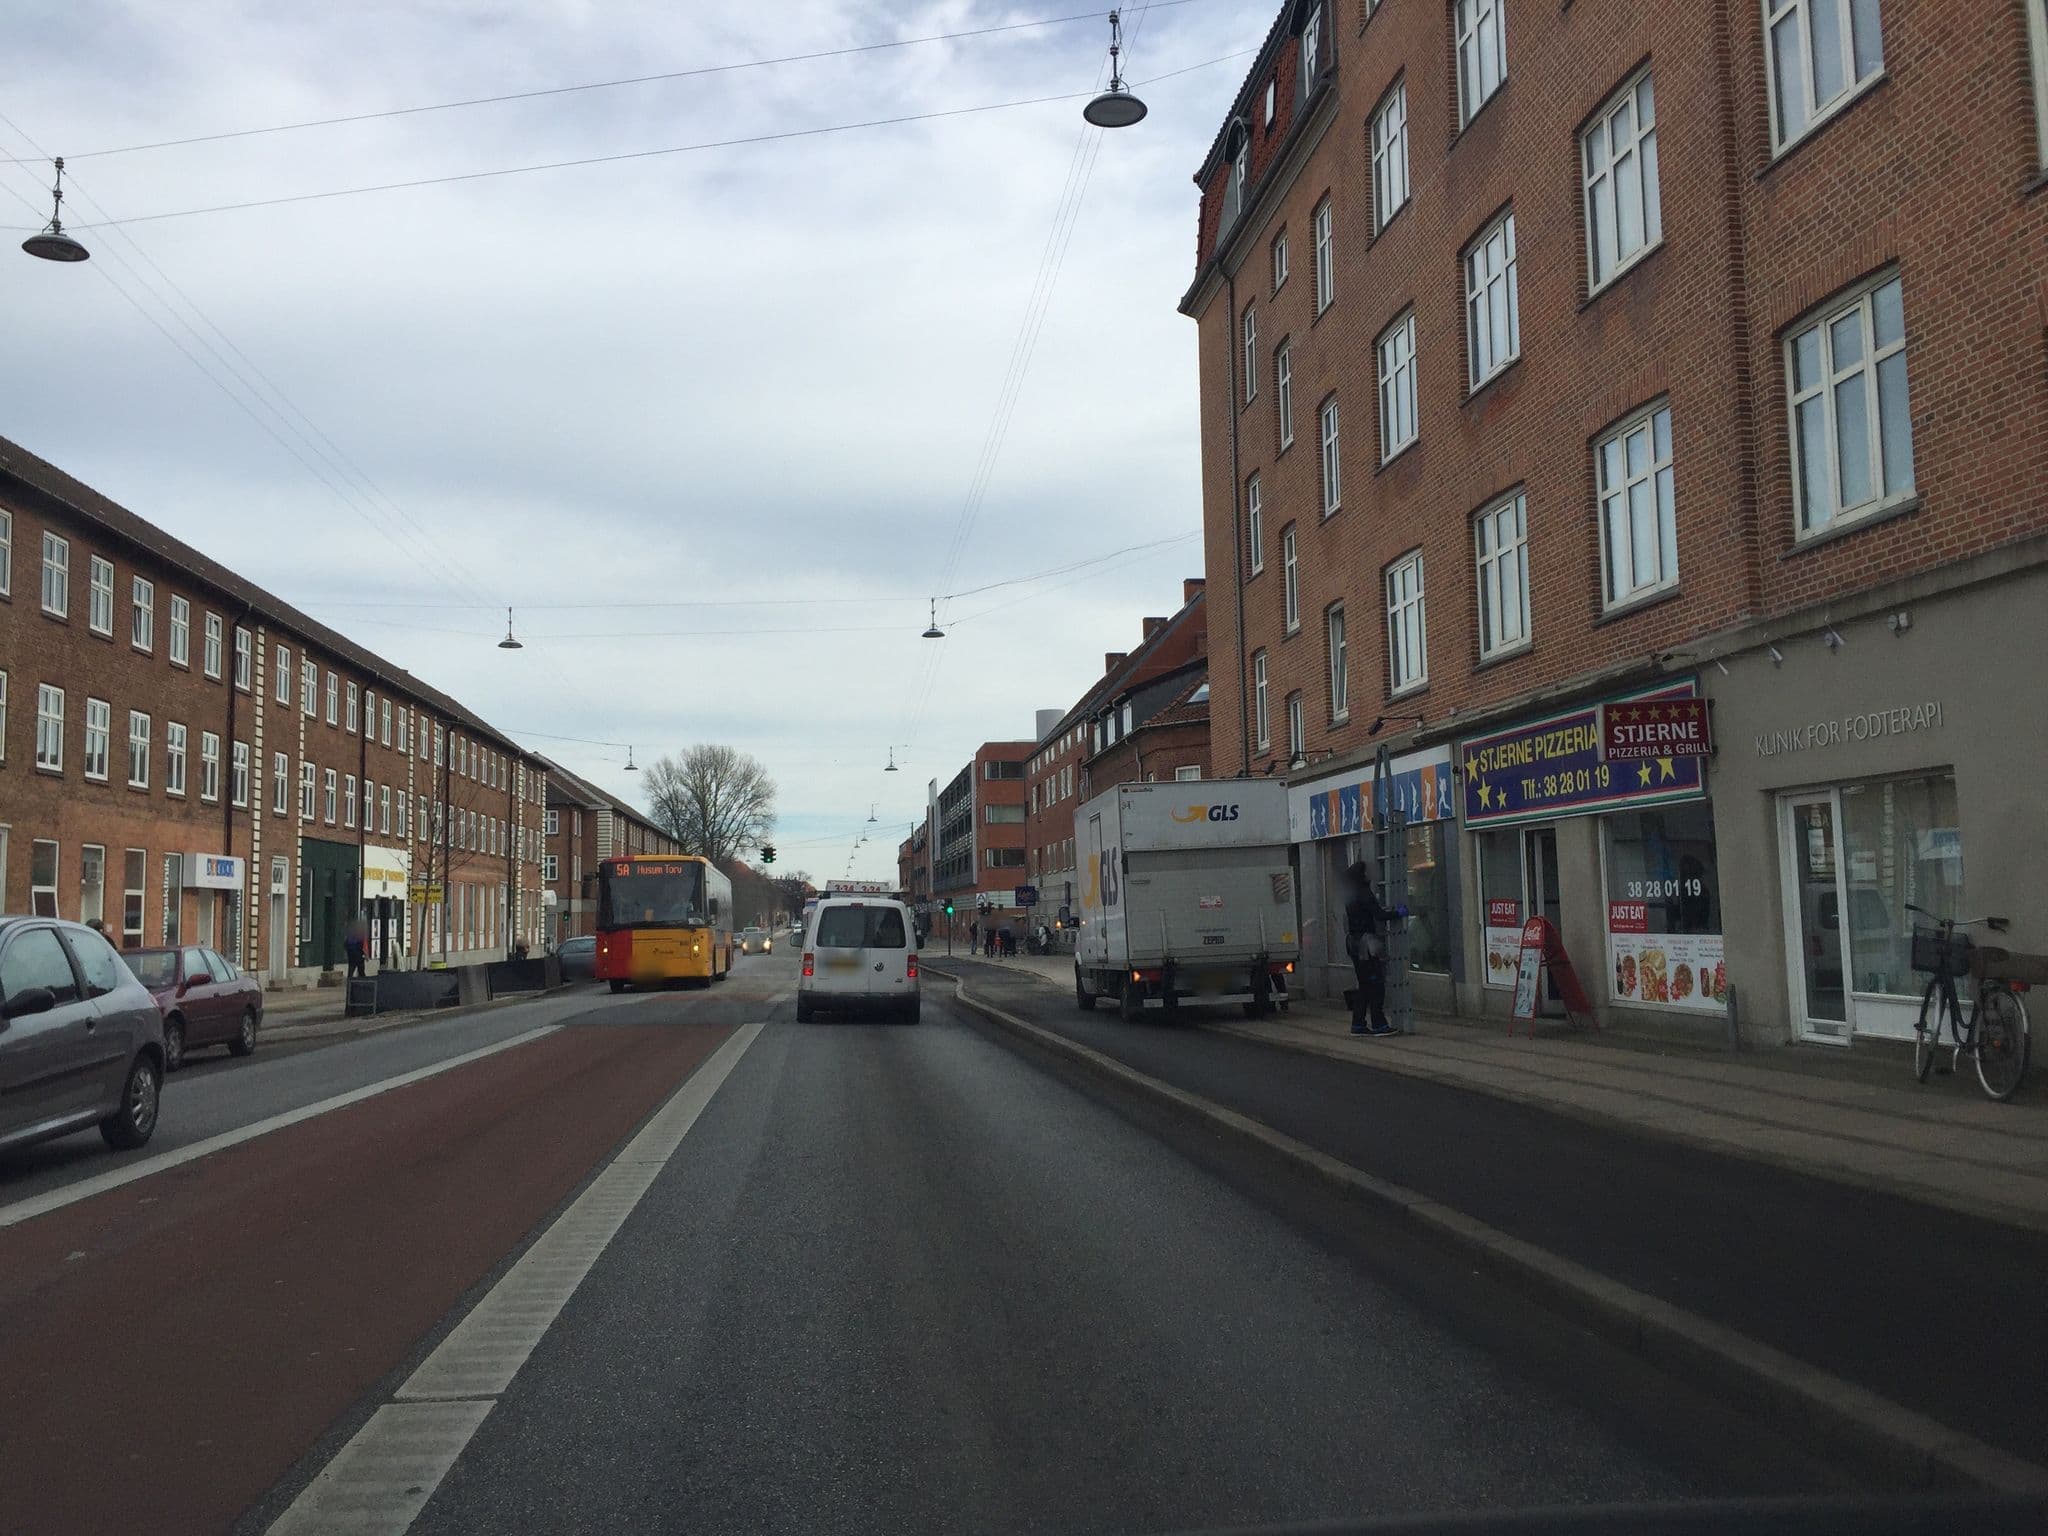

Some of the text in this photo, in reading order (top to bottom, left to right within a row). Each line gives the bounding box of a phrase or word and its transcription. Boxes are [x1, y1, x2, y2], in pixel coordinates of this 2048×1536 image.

[1613, 721, 1700, 744] STJERNE
[1756, 702, 1944, 757] KLINIK FOR FODTERAPI
[1479, 723, 1598, 773] STJERNE PIZZERIA
[1608, 742, 1710, 759] PIZZERIA & GRILL
[1521, 766, 1610, 800] Tlf.: 38 28 01 19
[1208, 804, 1239, 821] GLS
[616, 864, 630, 876] 5A
[637, 864, 663, 875] Husum
[1101, 847, 1118, 907] GLS
[1628, 879, 1701, 898] 38 28 01 19
[162, 858, 170, 946] ningsklinik
[1491, 903, 1515, 915] JUST EAT
[1611, 905, 1645, 920] JUST EAT
